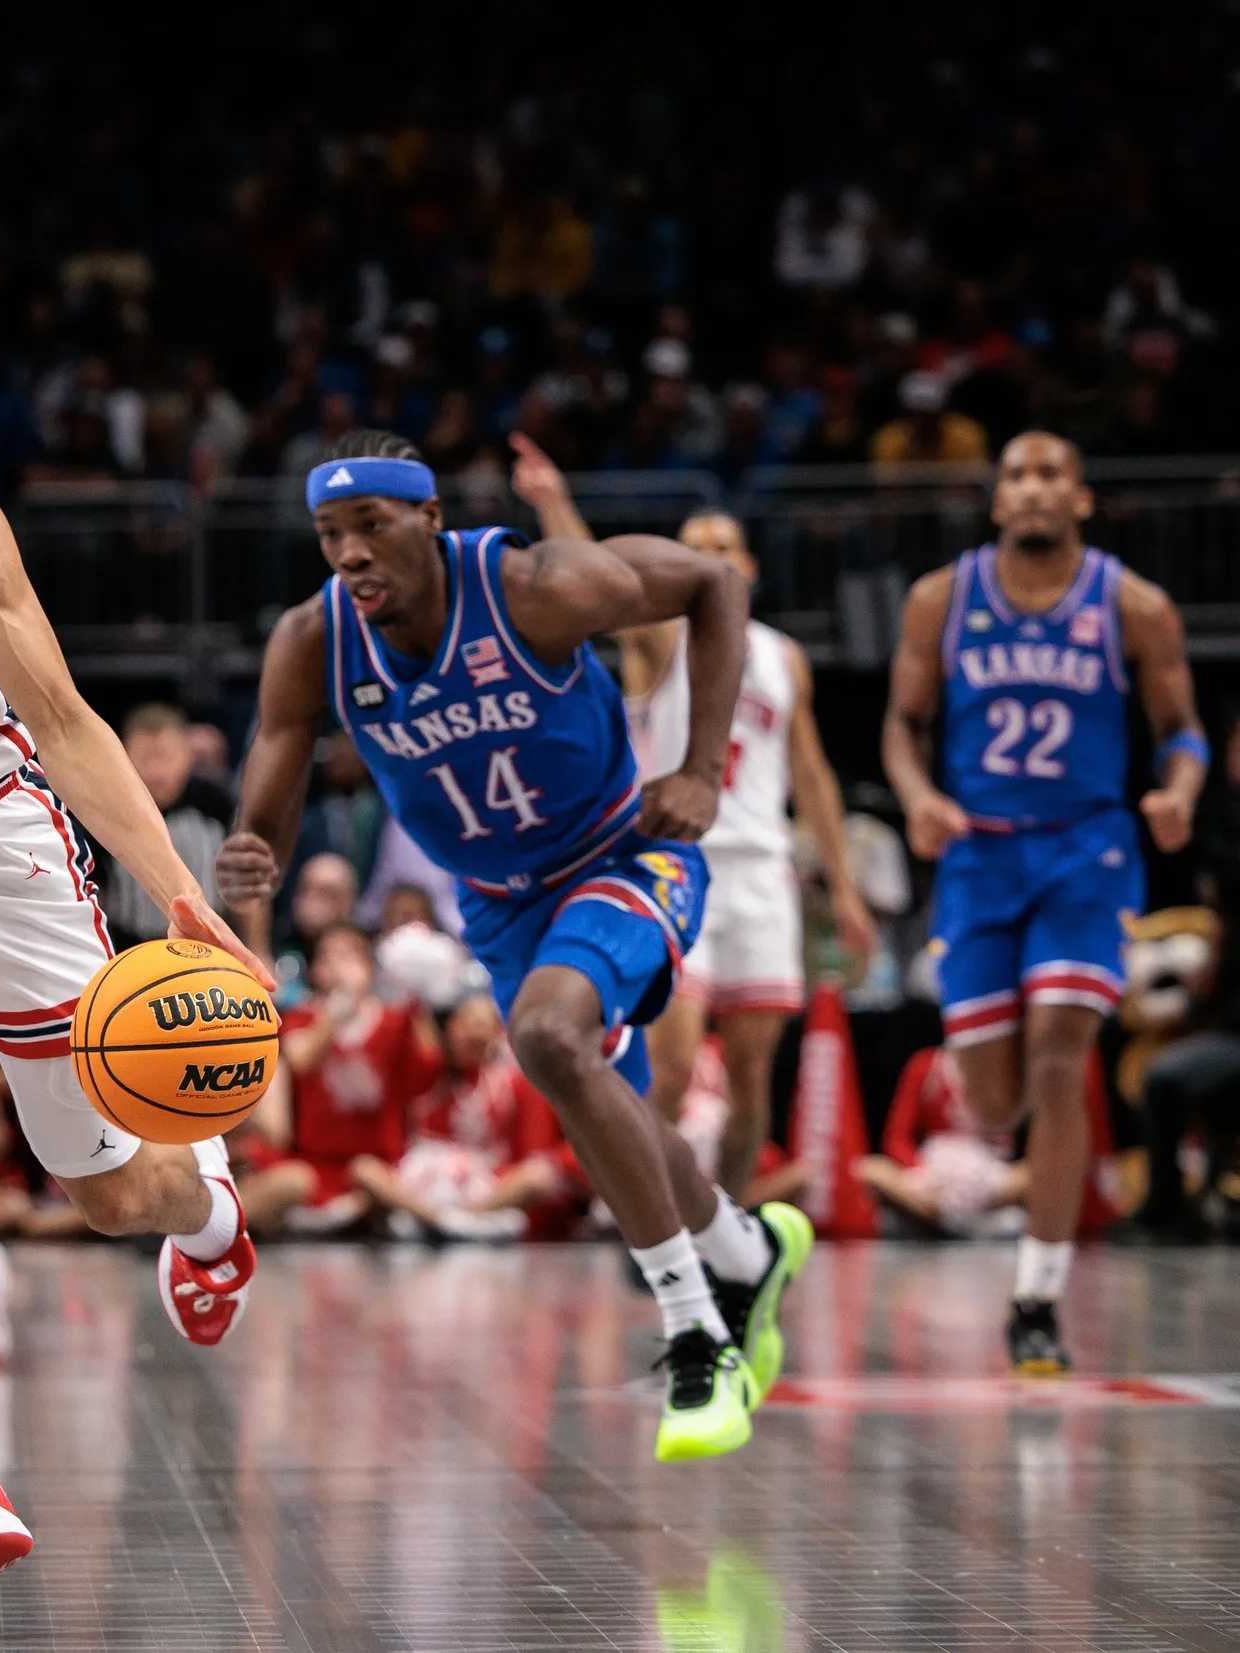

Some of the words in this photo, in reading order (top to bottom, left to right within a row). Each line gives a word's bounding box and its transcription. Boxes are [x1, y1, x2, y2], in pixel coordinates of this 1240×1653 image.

[980, 697, 1074, 780] 22
[424, 746, 551, 840] 14
[147, 986, 273, 1031] Wilson
[178, 1055, 266, 1092] NCAA
[219, 1091, 242, 1099] GAME
